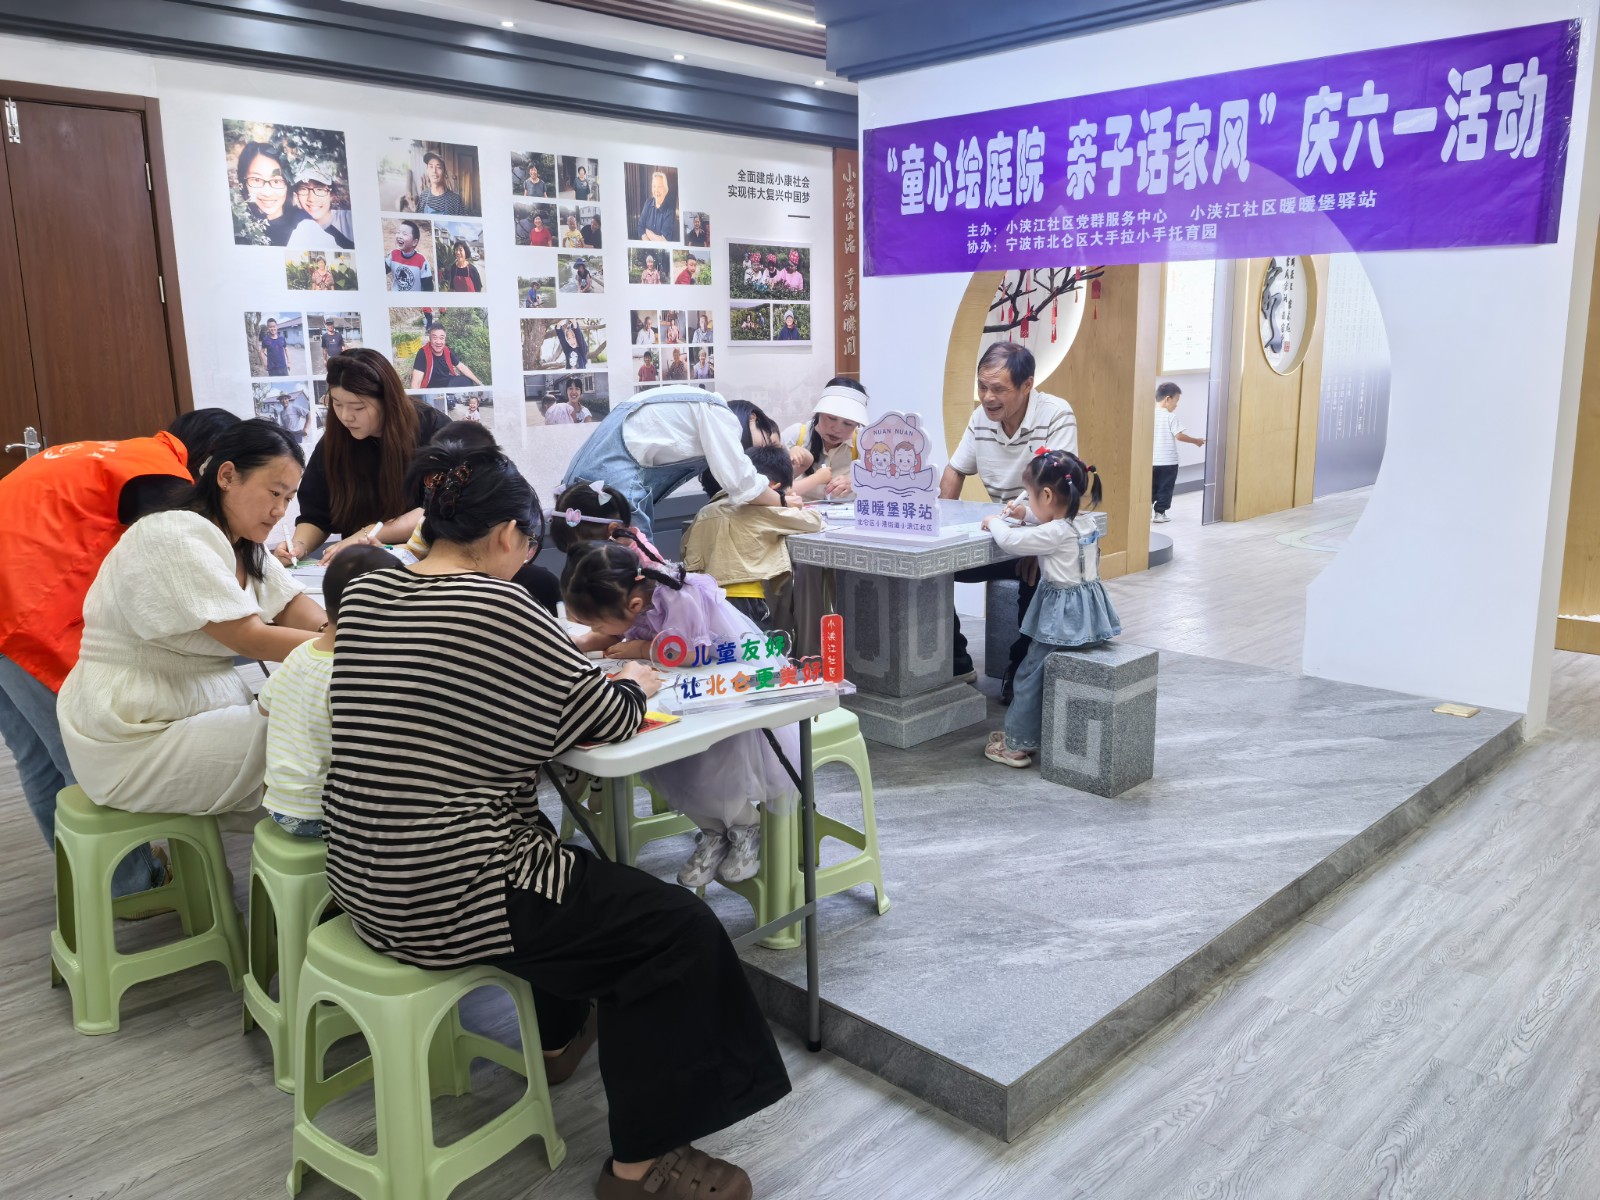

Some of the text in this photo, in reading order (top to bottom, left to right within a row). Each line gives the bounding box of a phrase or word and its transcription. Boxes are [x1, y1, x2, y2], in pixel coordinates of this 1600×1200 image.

[887, 56, 1549, 215] “童心绘庭院 亲子话家风” 庆六一活动
[737, 169, 810, 189] 全面建成小康社会
[728, 184, 811, 204] 实现伟大复兴中国梦
[1190, 190, 1378, 221] 小浃江社区暖暖堡驿站
[873, 428, 914, 437] NUAN NUAN
[857, 499, 932, 520] 暖暖堡驿站
[691, 635, 786, 668] 儿童友好
[680, 661, 823, 700] 让北仑更美好
